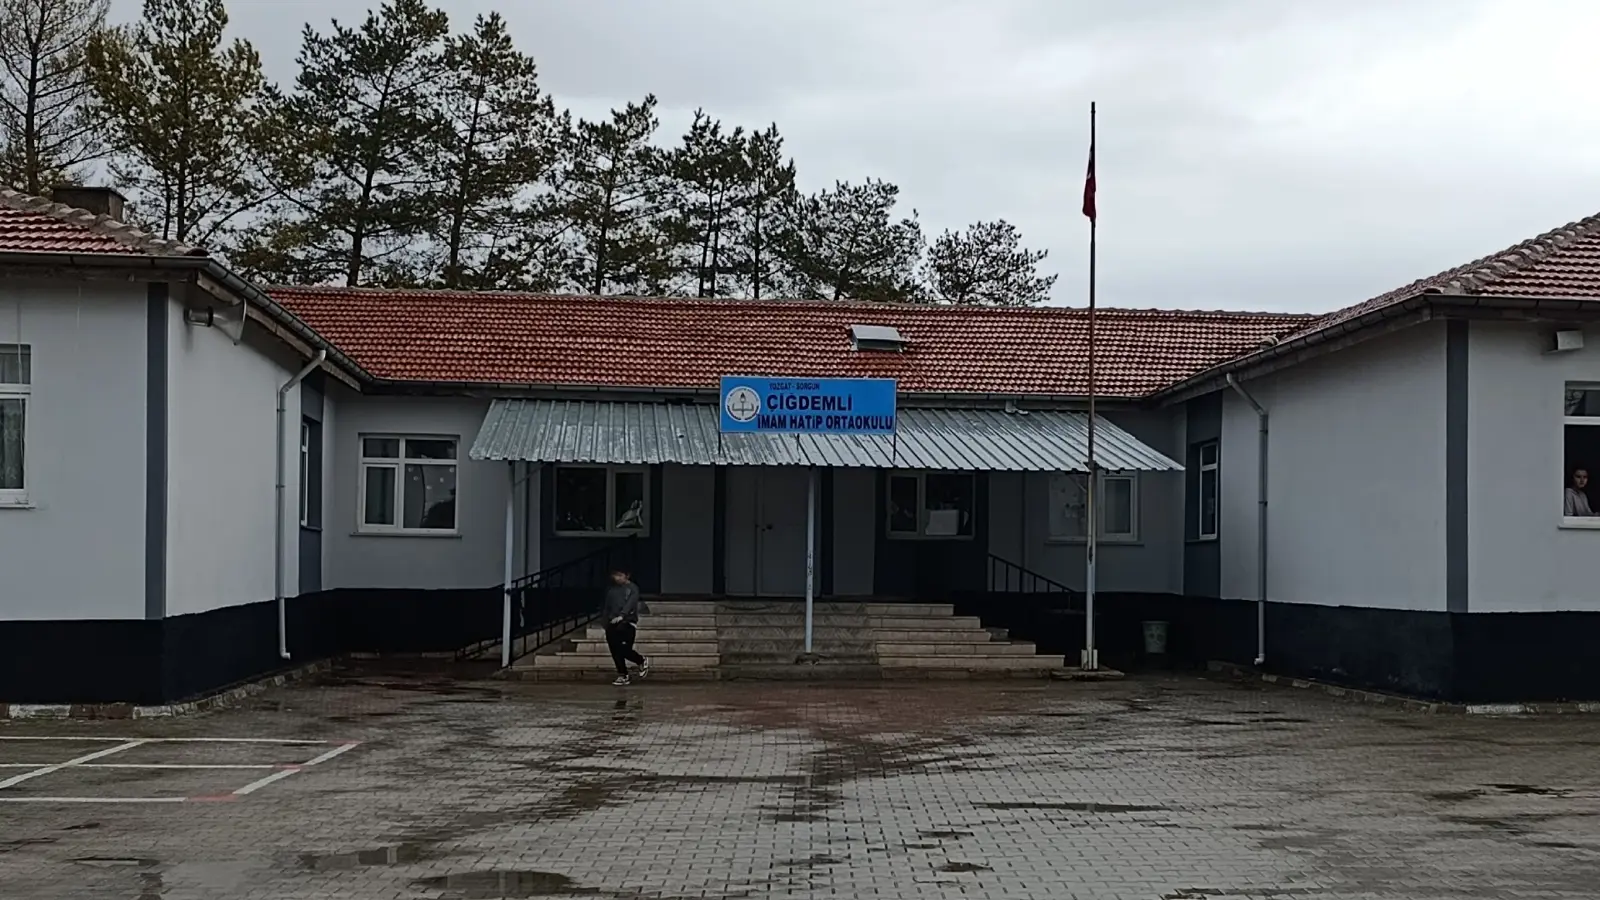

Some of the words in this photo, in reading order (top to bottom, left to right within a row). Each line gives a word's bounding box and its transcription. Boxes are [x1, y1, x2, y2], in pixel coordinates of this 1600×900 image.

[769, 382, 791, 390] YOZGAT
[796, 382, 820, 390] SORGUN
[766, 393, 852, 412] ÇİĞDEMLİ
[757, 413, 786, 429] İMAM
[825, 415, 893, 430] ORTAOKULU
